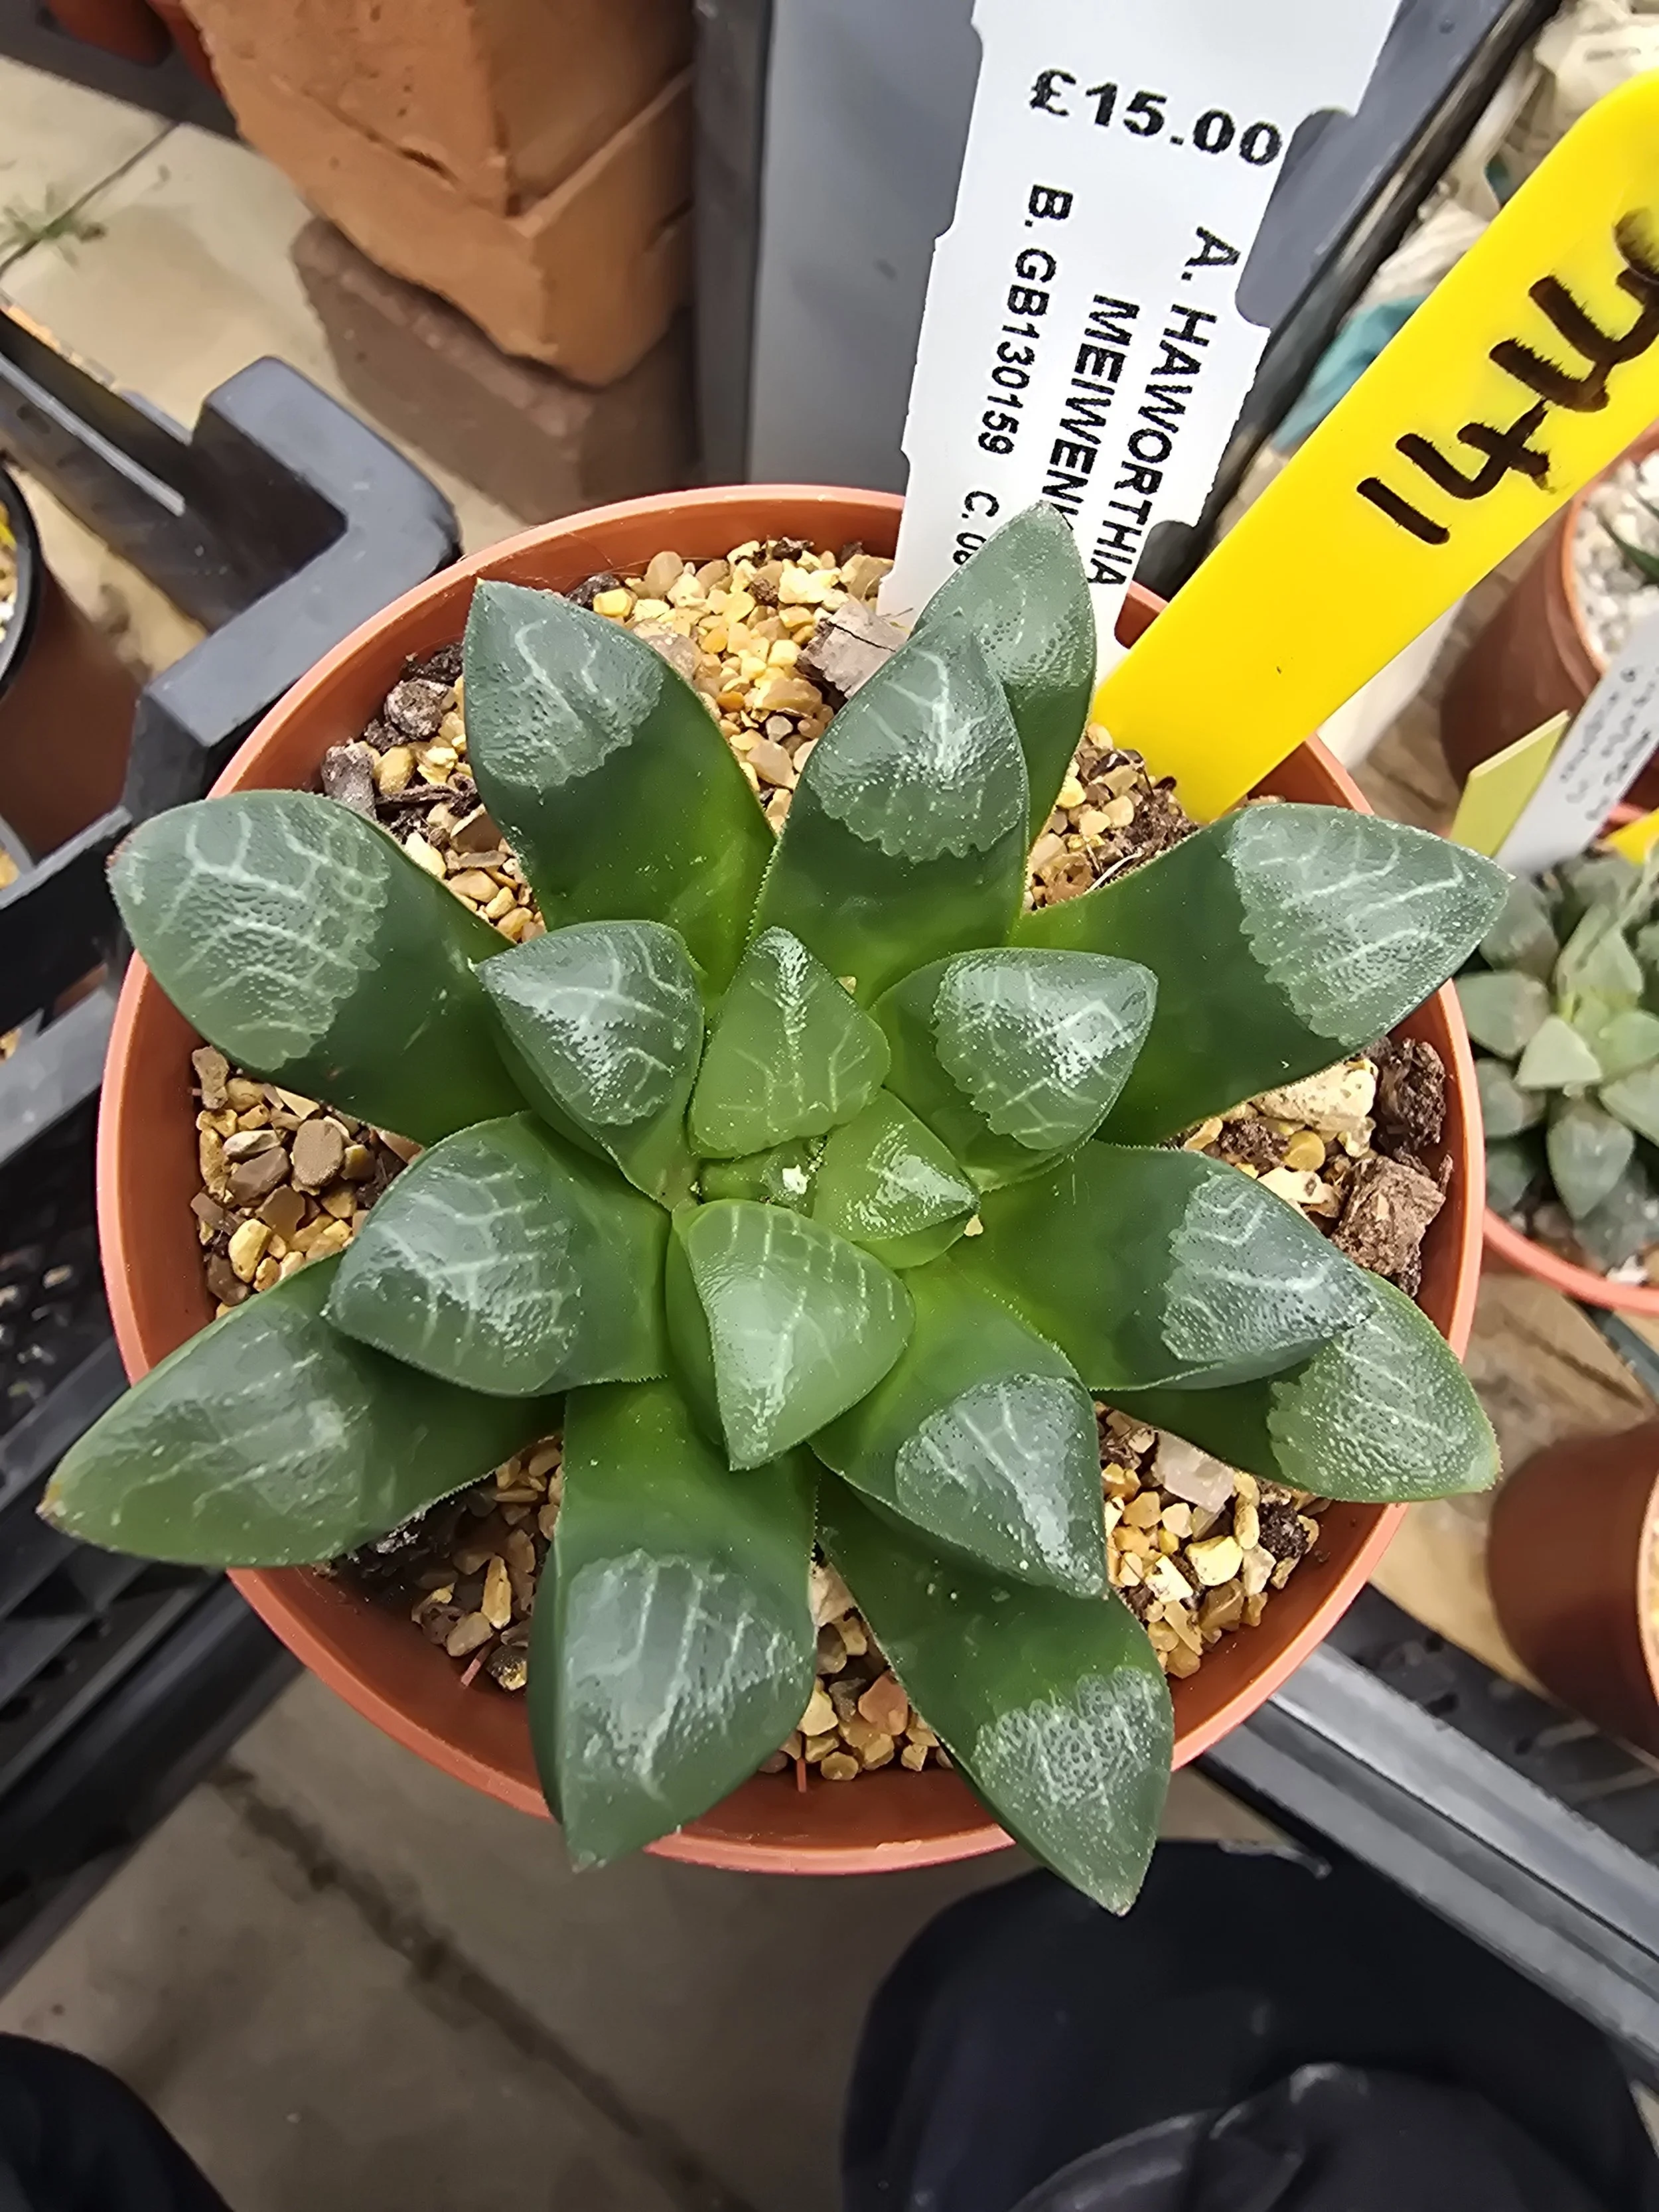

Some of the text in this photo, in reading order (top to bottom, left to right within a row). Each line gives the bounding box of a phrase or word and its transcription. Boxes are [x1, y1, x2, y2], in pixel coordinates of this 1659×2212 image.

[1030, 70, 1283, 167] £15.00
[1024, 184, 1074, 228] B.
[977, 247, 1057, 455] GB130159
[1086, 226, 1241, 586] A. HAWORTHIA
[961, 490, 1000, 520] C.
